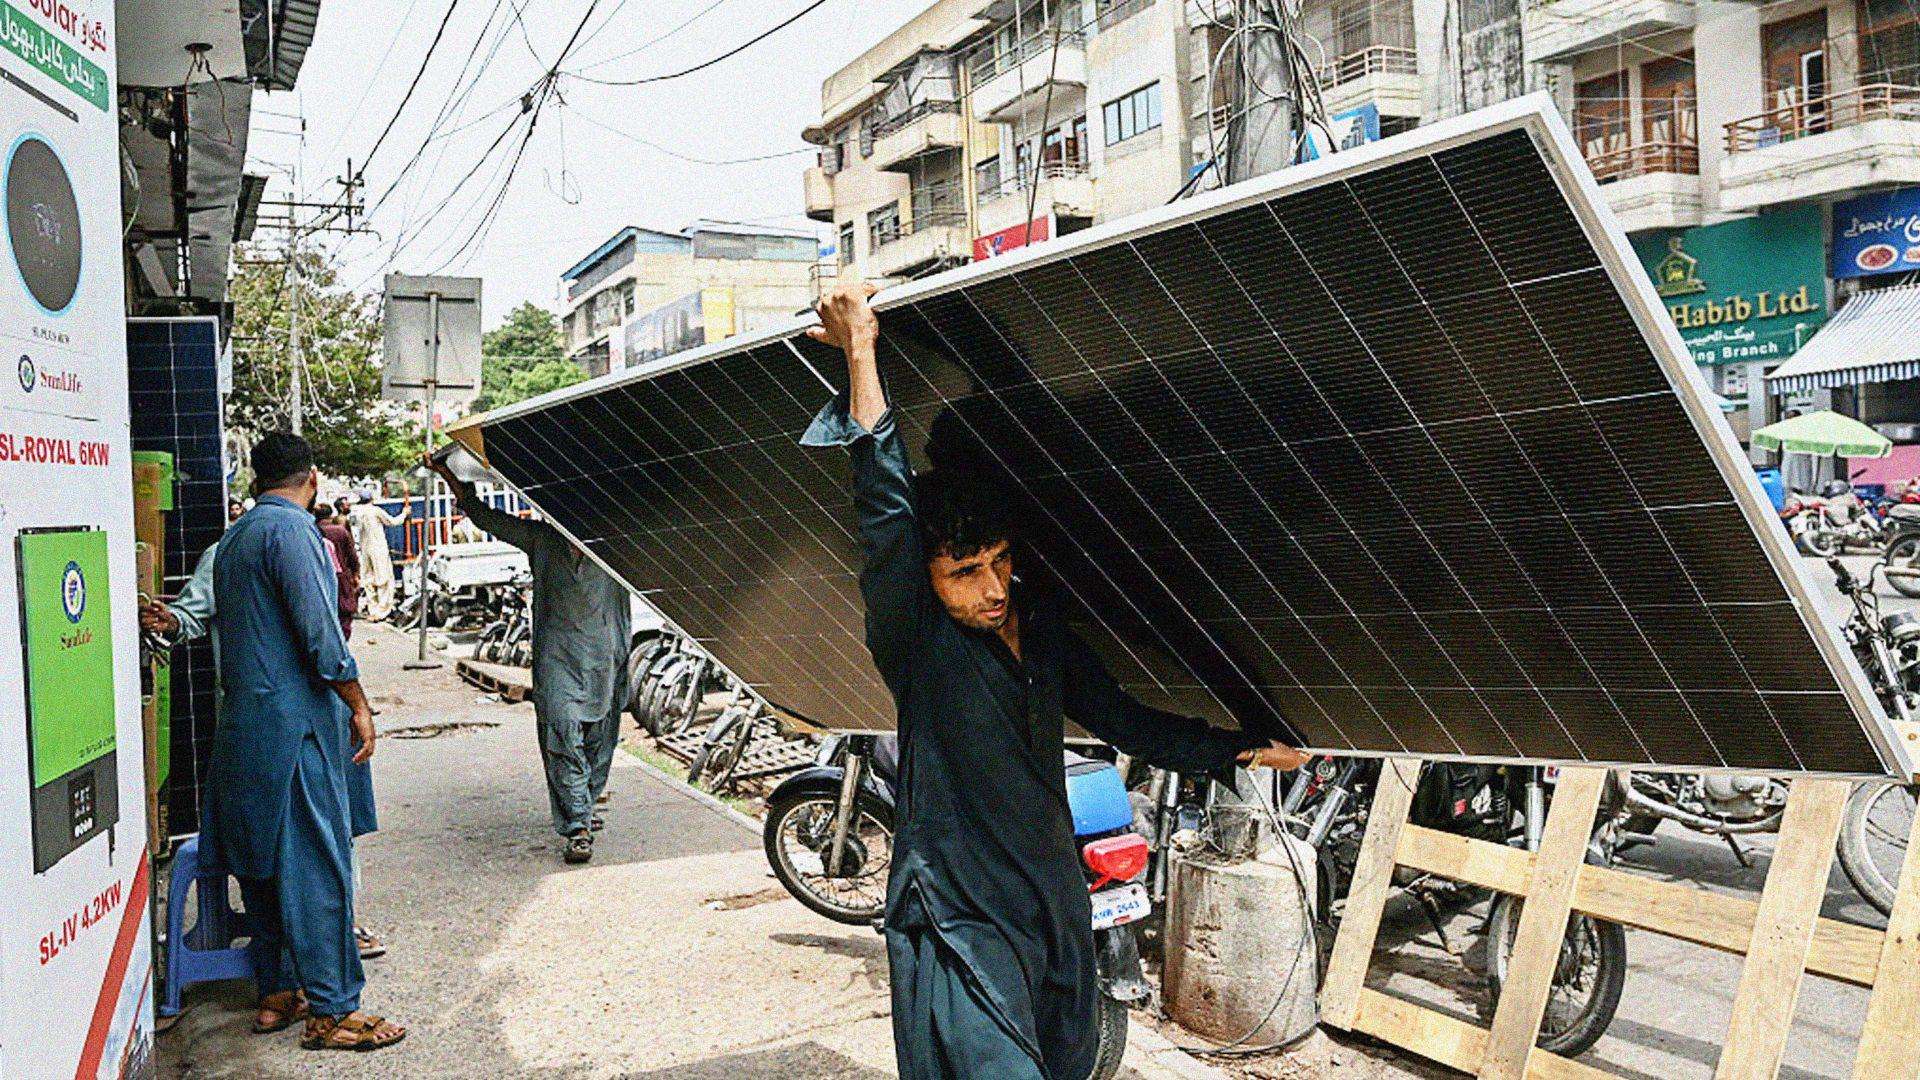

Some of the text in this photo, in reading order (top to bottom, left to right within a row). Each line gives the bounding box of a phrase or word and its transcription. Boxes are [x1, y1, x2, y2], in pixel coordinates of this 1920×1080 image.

[1671, 285, 1820, 329] Habib Ltd.
[1691, 341, 1778, 363] ing Branch
[0, 433, 110, 466] SL-ROYAL 6KW
[39, 880, 123, 966] SL-IV 4.2KW
